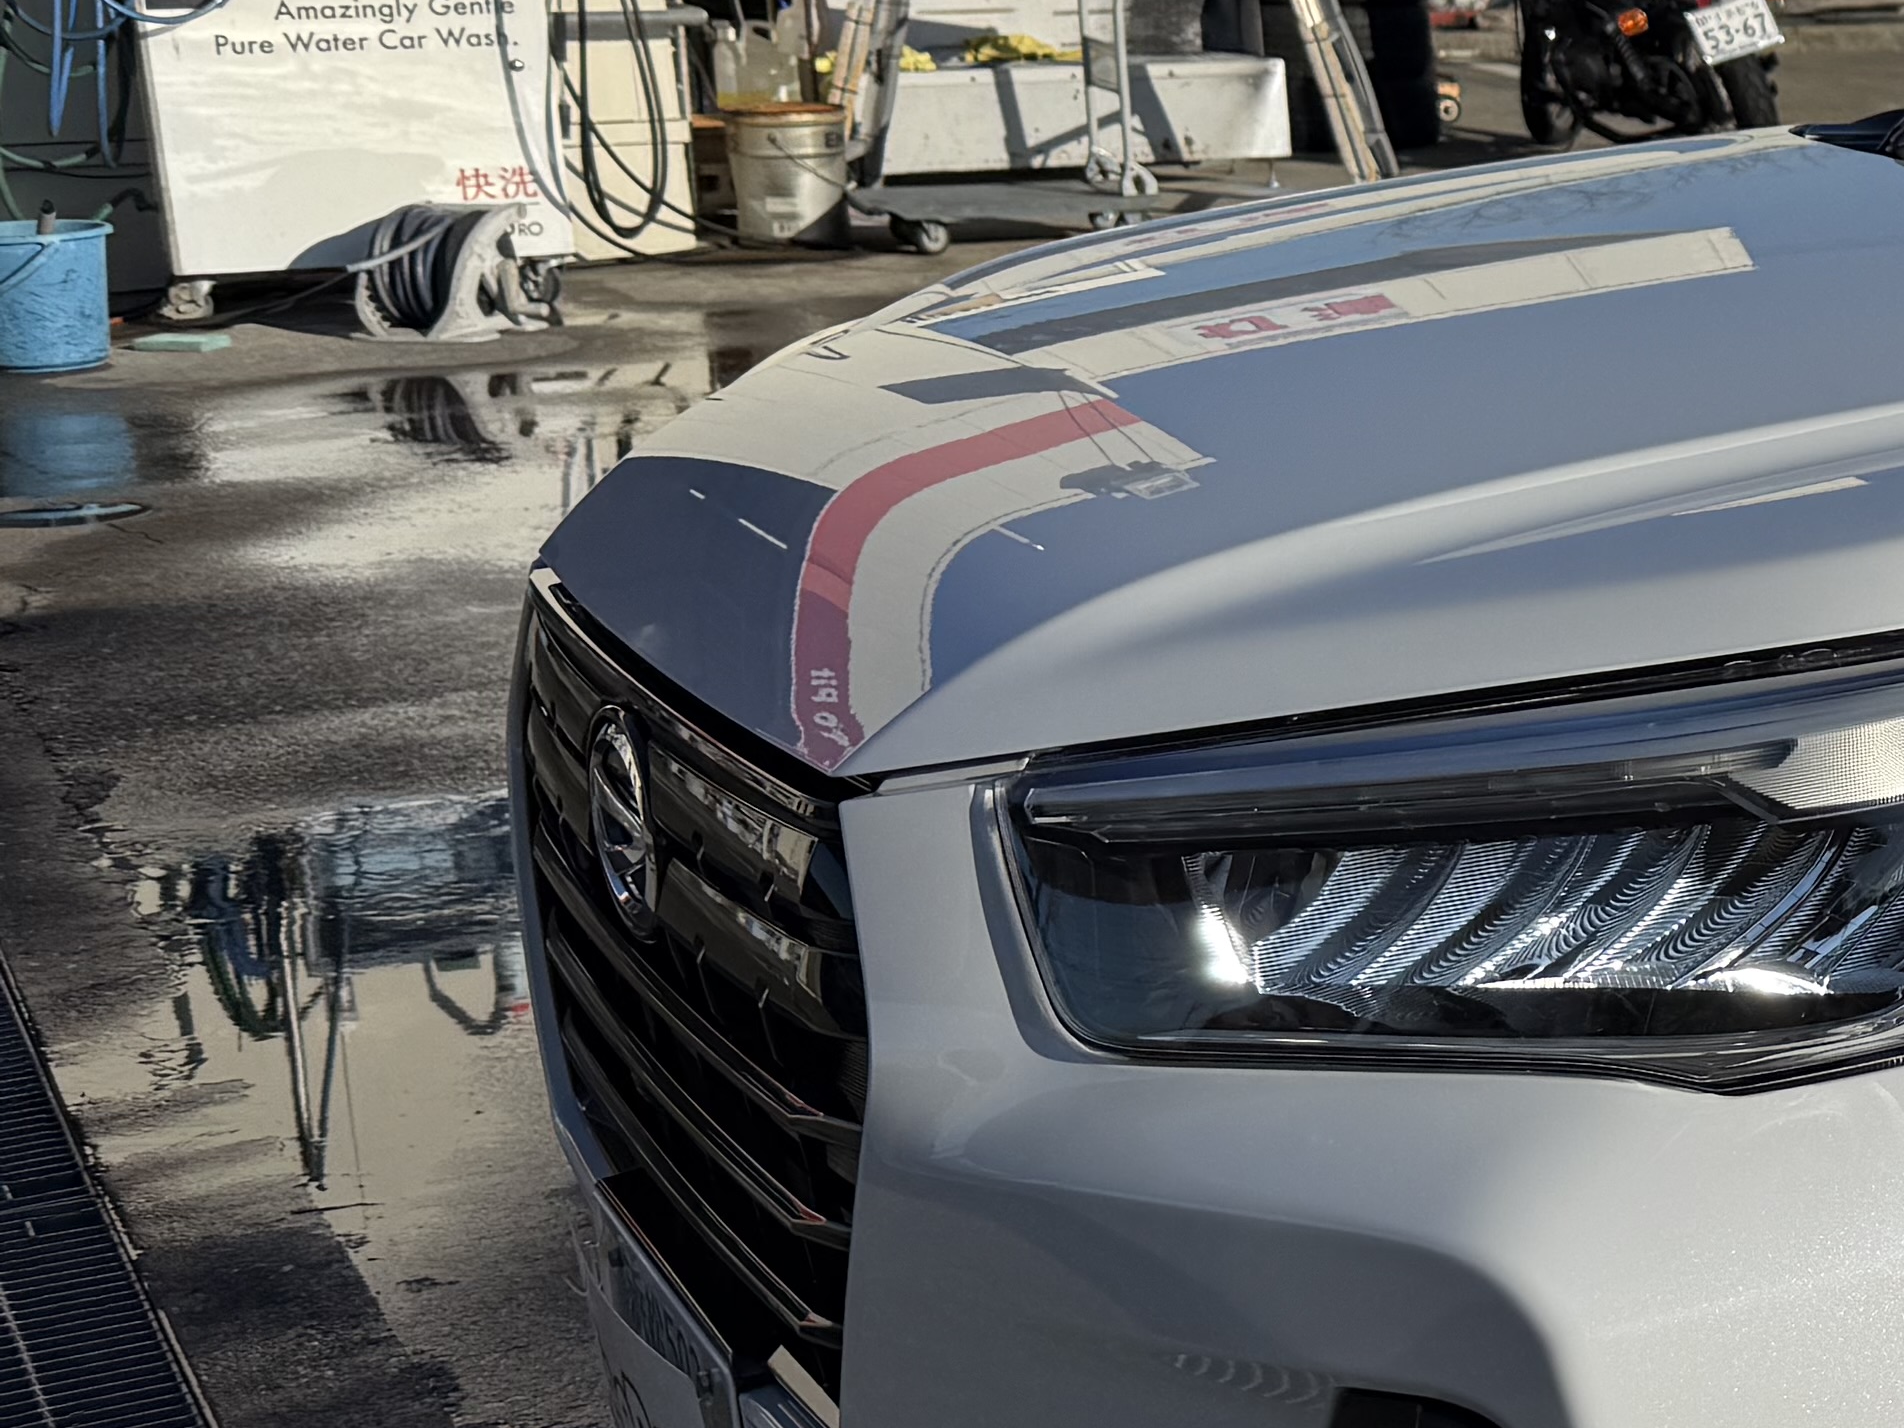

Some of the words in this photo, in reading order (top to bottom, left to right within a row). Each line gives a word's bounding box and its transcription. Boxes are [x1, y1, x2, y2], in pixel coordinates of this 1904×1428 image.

[214, 34, 274, 55] Pure
[283, 31, 369, 53] Water
[378, 29, 428, 50] Car
[456, 165, 538, 201] 快洗
